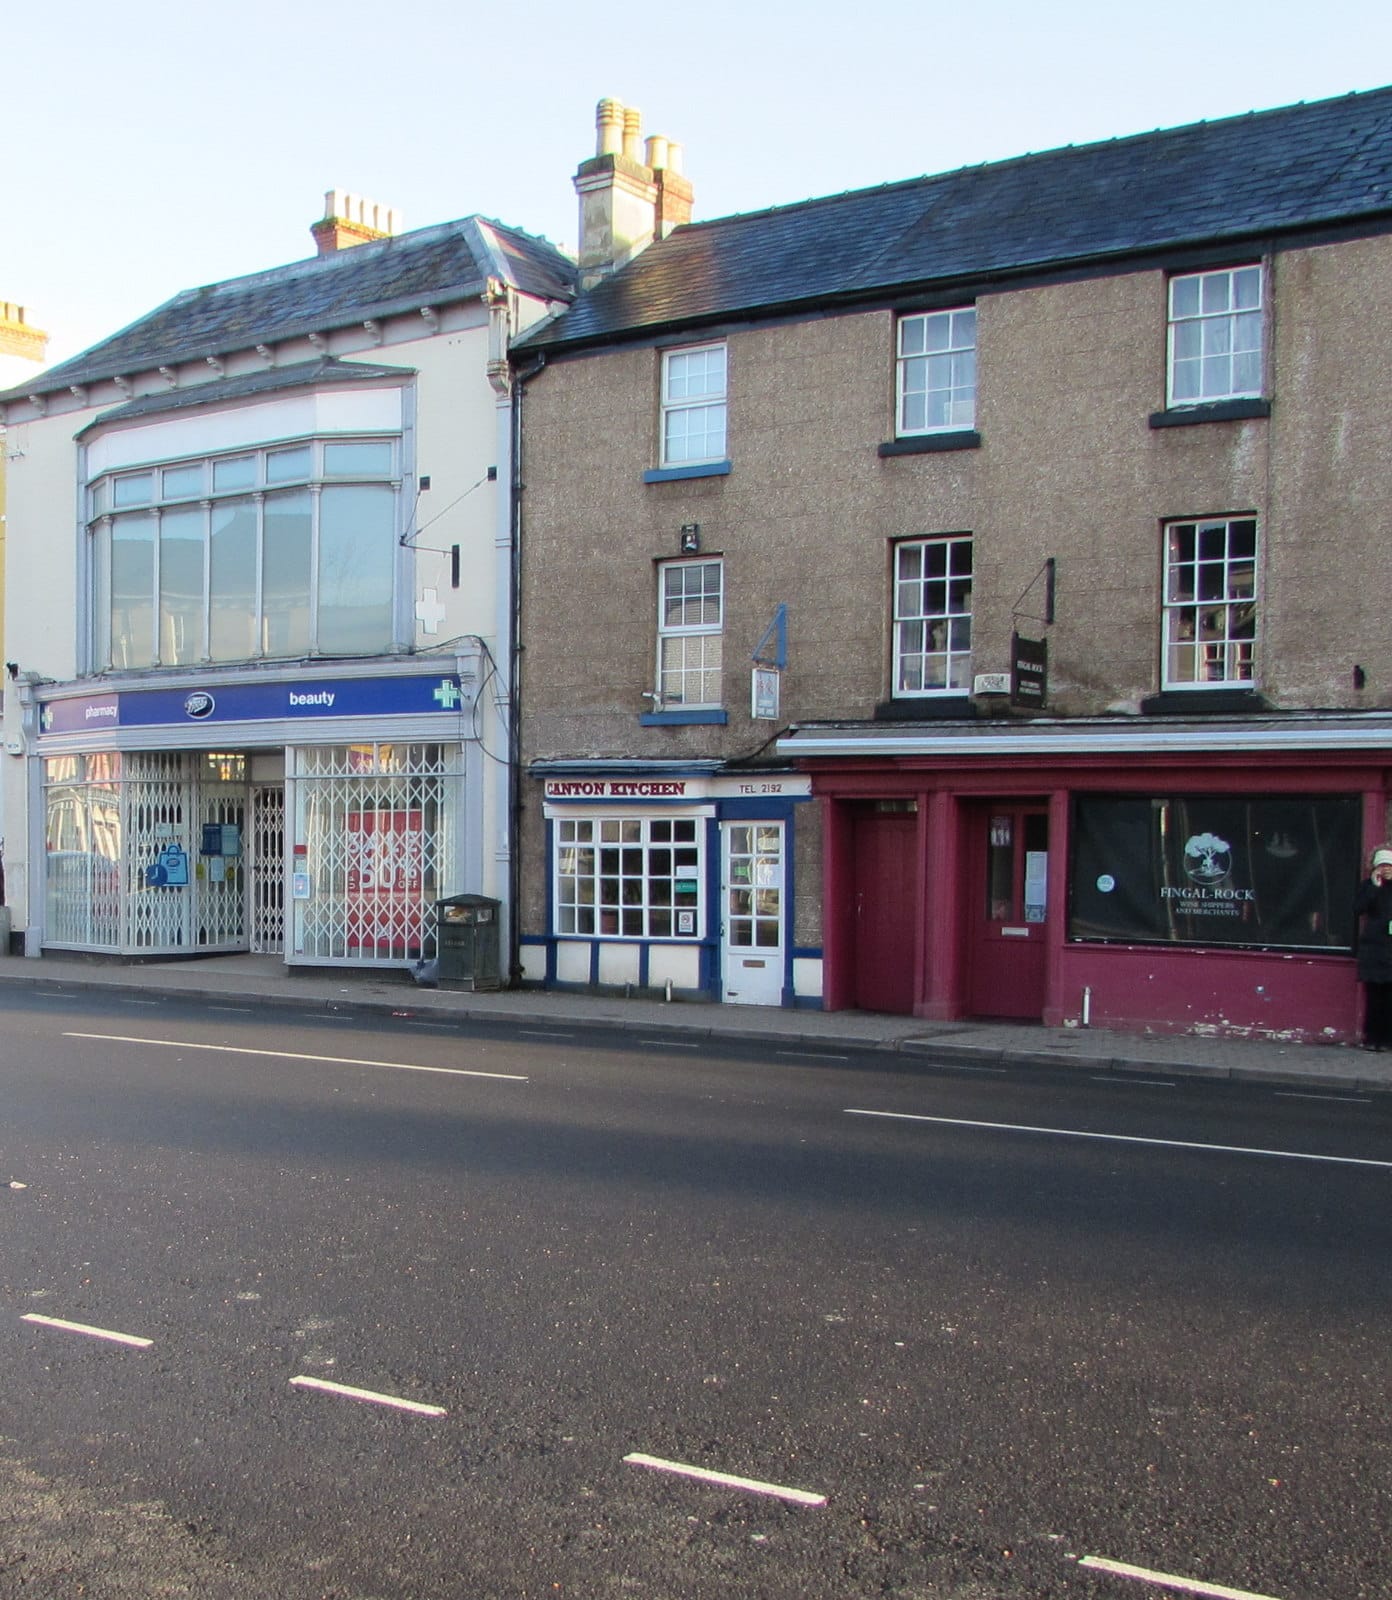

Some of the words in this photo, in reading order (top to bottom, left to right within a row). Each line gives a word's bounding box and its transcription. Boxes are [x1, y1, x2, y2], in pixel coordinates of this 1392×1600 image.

[290, 691, 335, 706] beauty
[85, 705, 117, 720] pharmacy
[547, 782, 605, 796] CANTON
[610, 782, 685, 796] KITCHEN
[740, 784, 756, 793] TEL
[761, 784, 782, 793] 2192
[1160, 887, 1254, 900] FINGAL-ROCK
